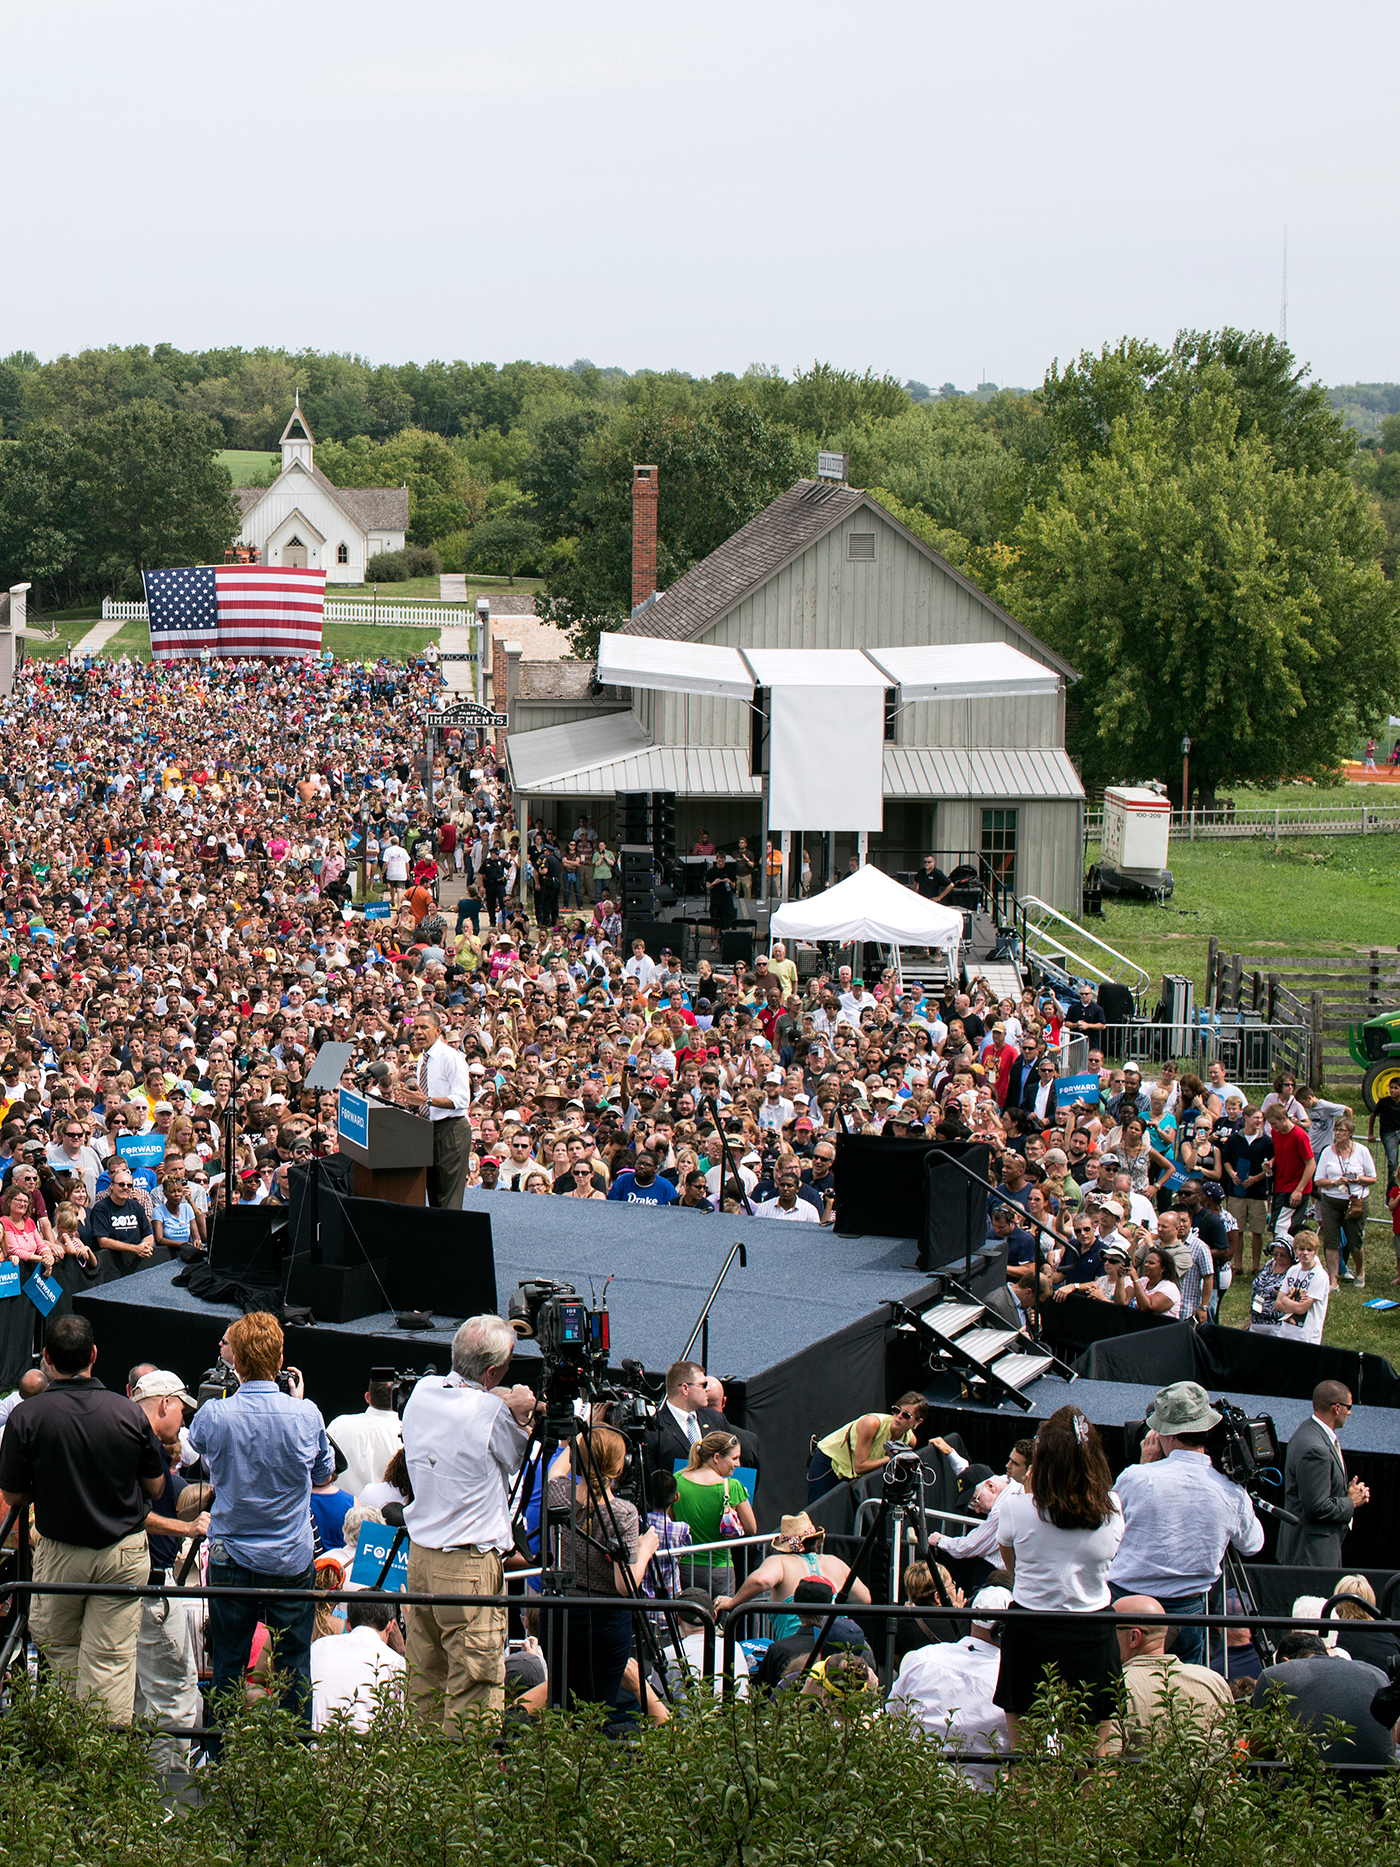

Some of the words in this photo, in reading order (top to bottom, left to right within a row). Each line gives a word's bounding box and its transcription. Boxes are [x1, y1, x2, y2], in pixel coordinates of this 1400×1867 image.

[429, 716, 507, 725] IMPLEMENTS.
[627, 1192, 658, 1206] Drake
[111, 1214, 138, 1227] 2012
